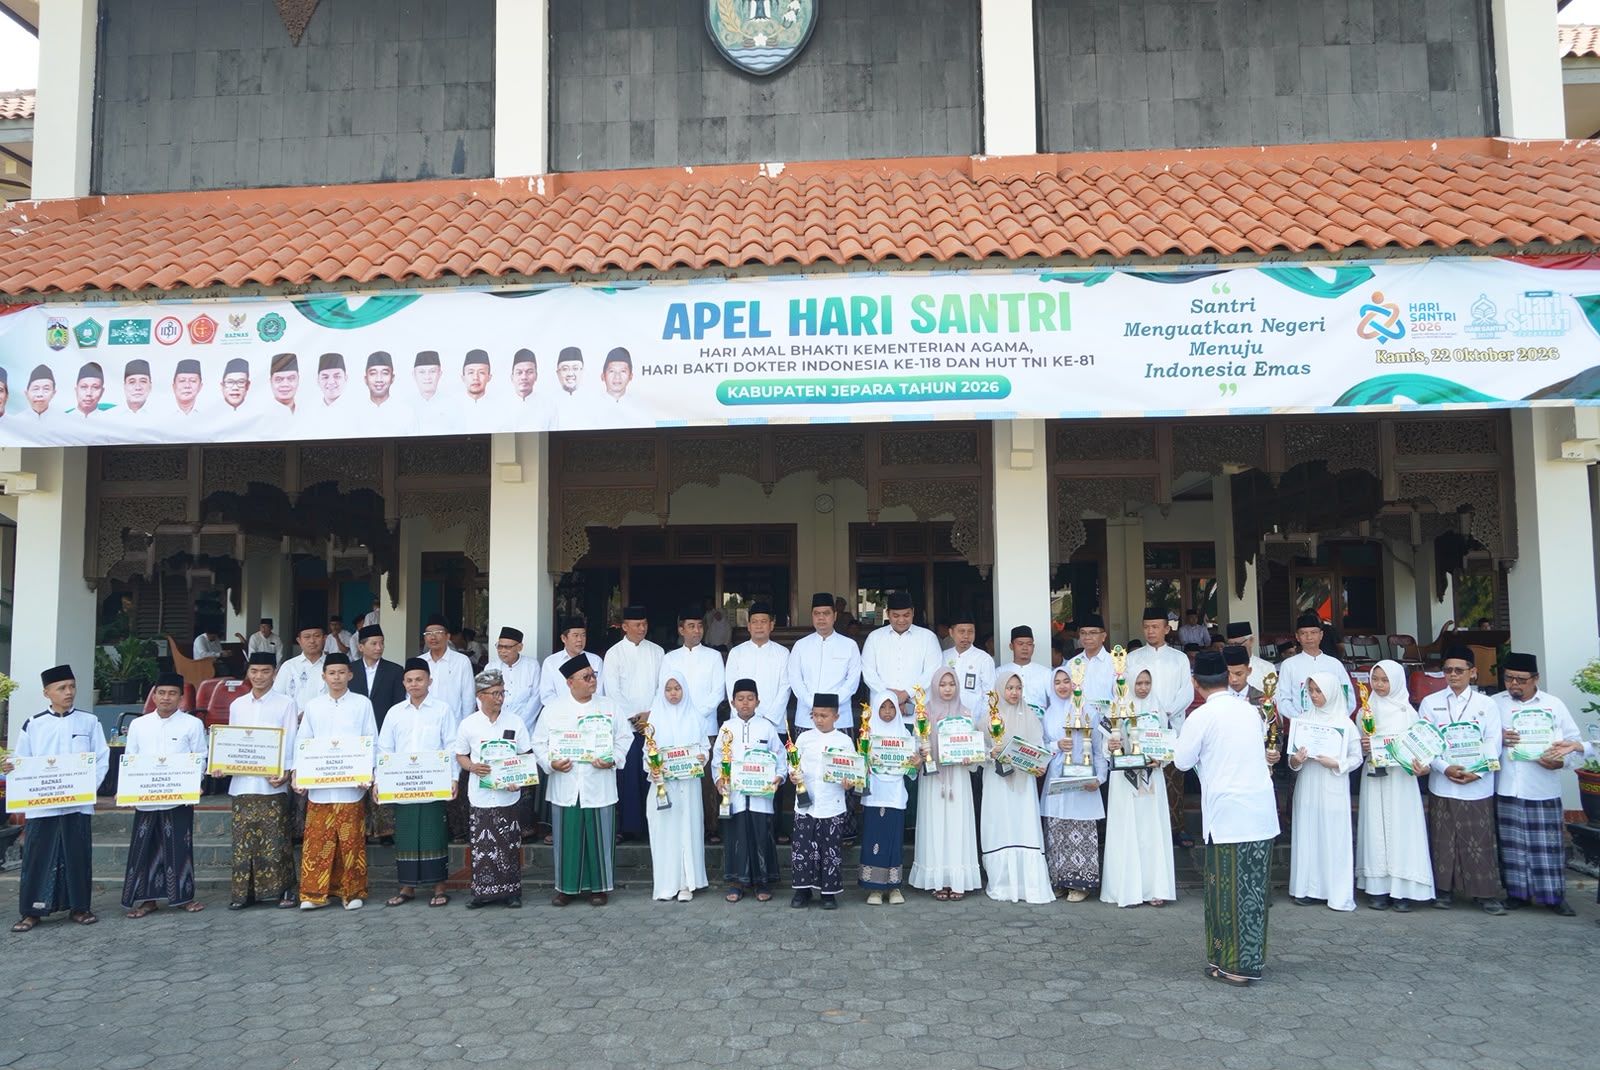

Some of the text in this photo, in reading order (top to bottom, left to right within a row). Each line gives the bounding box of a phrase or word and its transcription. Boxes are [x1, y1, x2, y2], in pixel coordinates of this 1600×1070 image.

[1190, 298, 1256, 314] Santri
[1409, 302, 1440, 312] HARI
[662, 292, 1072, 340] APEL HARI SANTRI
[1410, 312, 1456, 322] SANTRI
[1124, 316, 1326, 340] Menguatkan Negeri
[1410, 322, 1442, 332] 2026
[700, 342, 1034, 358] HARI AMAL BHAKTI KEMENTERIAN AGAMA,
[1189, 340, 1264, 358] Menuju
[1376, 347, 1560, 365] Kamis, 22 Oktober 2026
[642, 354, 1095, 376] HARI BAKTI DOKTER INDONESIA KE-118 DAN HUT TNI KE-81
[1144, 361, 1312, 378] Indonesia Emas
[728, 381, 1000, 398] KABUPATEN JEPARA TAHUN 2026
[28, 796, 76, 806] KACAMATA
